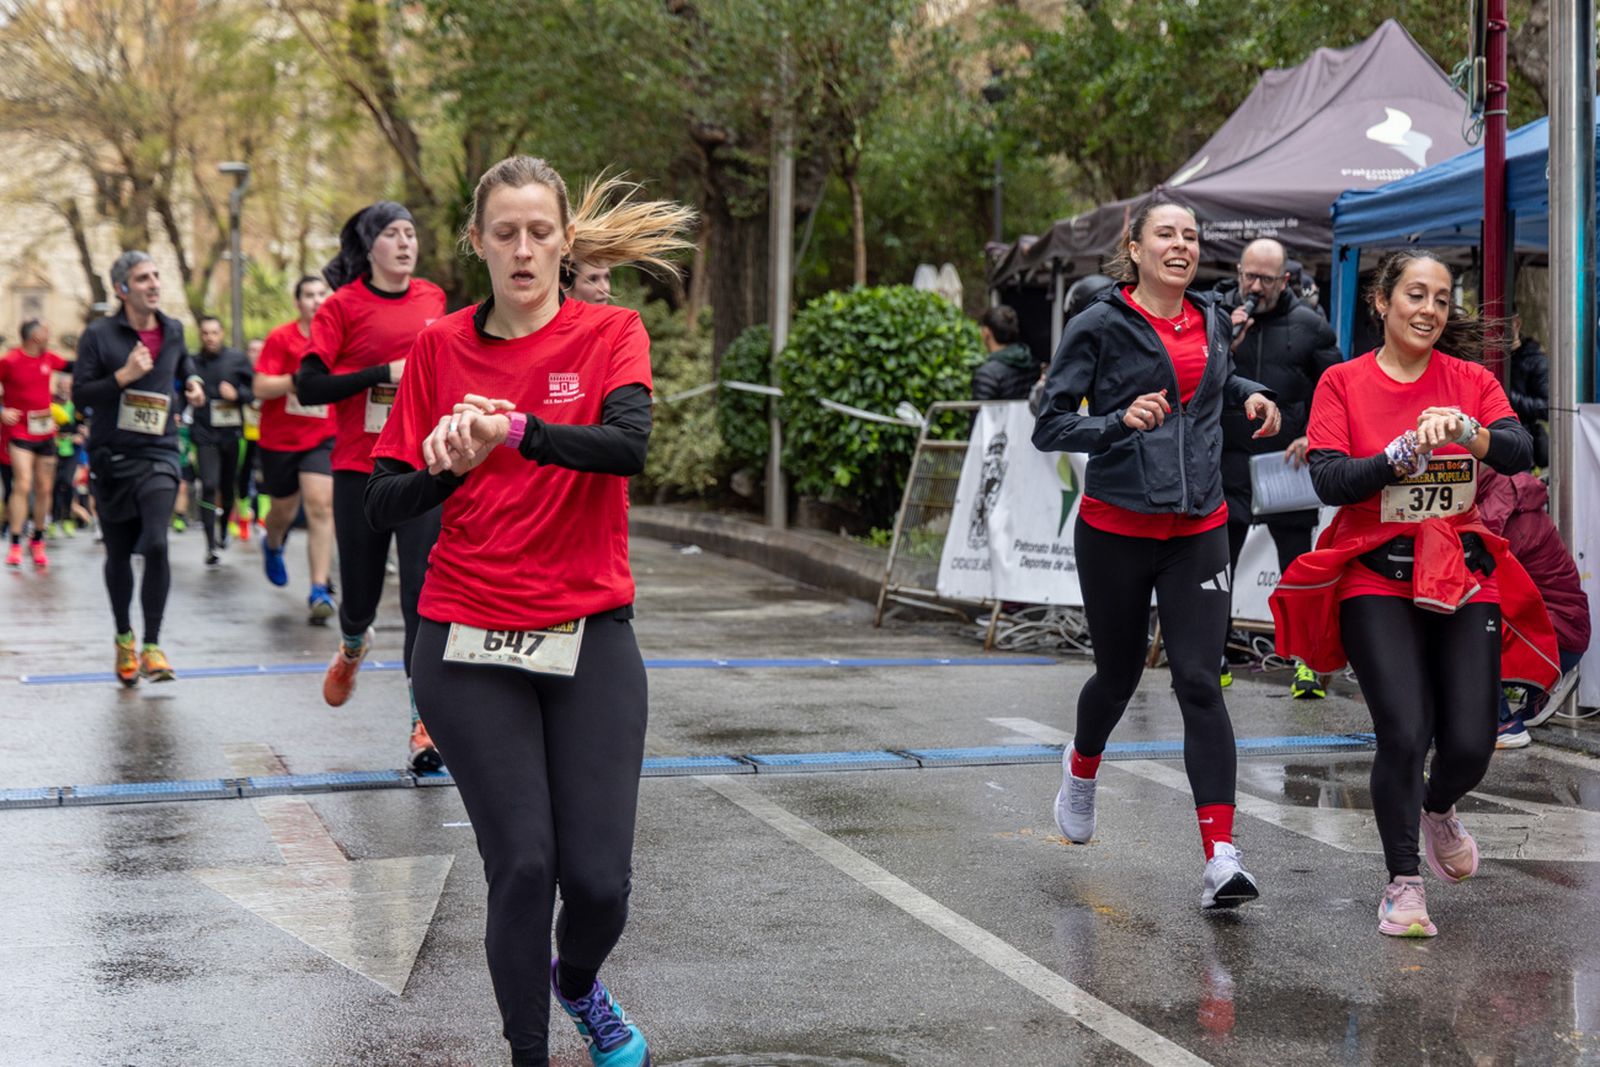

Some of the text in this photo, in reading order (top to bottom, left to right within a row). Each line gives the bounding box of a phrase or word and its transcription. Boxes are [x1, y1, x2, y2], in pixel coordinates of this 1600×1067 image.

[1244, 219, 1285, 228] Municipal
[1287, 218, 1298, 227] de
[134, 409, 158, 425] 903
[1437, 471, 1471, 482] POPULAR
[1408, 486, 1453, 512] 379
[1013, 539, 1049, 554] Patronato
[1020, 555, 1052, 570] Deportes
[483, 630, 546, 657] 647
